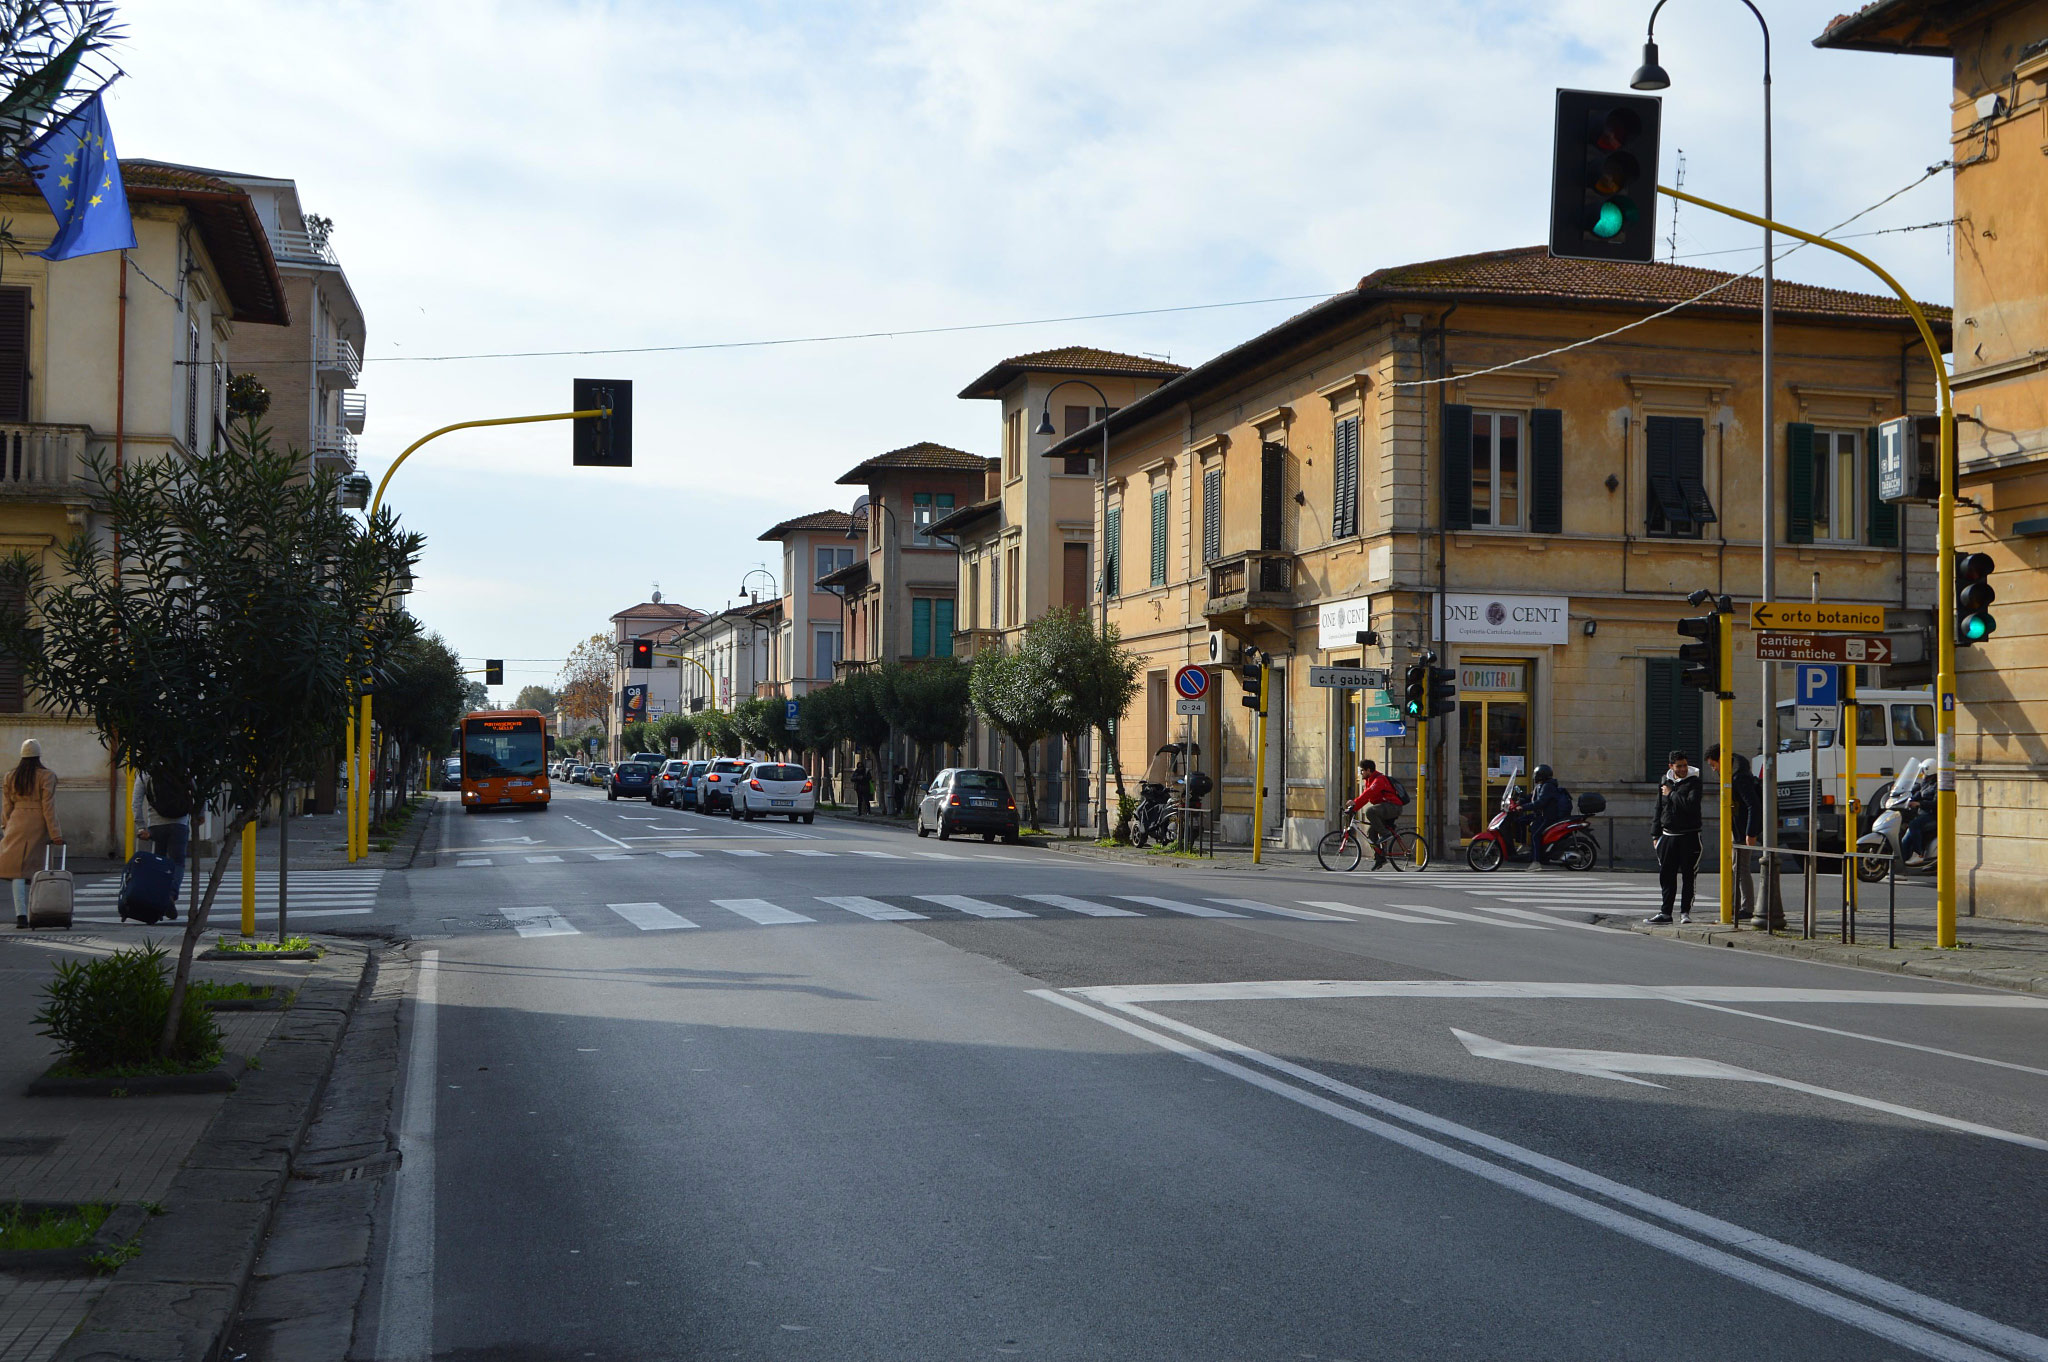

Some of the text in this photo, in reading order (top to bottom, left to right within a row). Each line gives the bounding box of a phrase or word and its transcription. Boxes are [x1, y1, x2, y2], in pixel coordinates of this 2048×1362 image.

[1883, 424, 1898, 472] T
[1322, 607, 1366, 628] ONE CENT
[1512, 606, 1562, 623] CENT
[1781, 610, 1880, 625] orto botanico
[1760, 636, 1812, 647] cantiere
[1760, 648, 1836, 660] navi antiche
[1319, 674, 1375, 686] c. f. gabba
[1462, 670, 1516, 688] COPISTERIA
[1806, 668, 1828, 699] P
[627, 688, 641, 696] Q8
[787, 703, 797, 717] P
